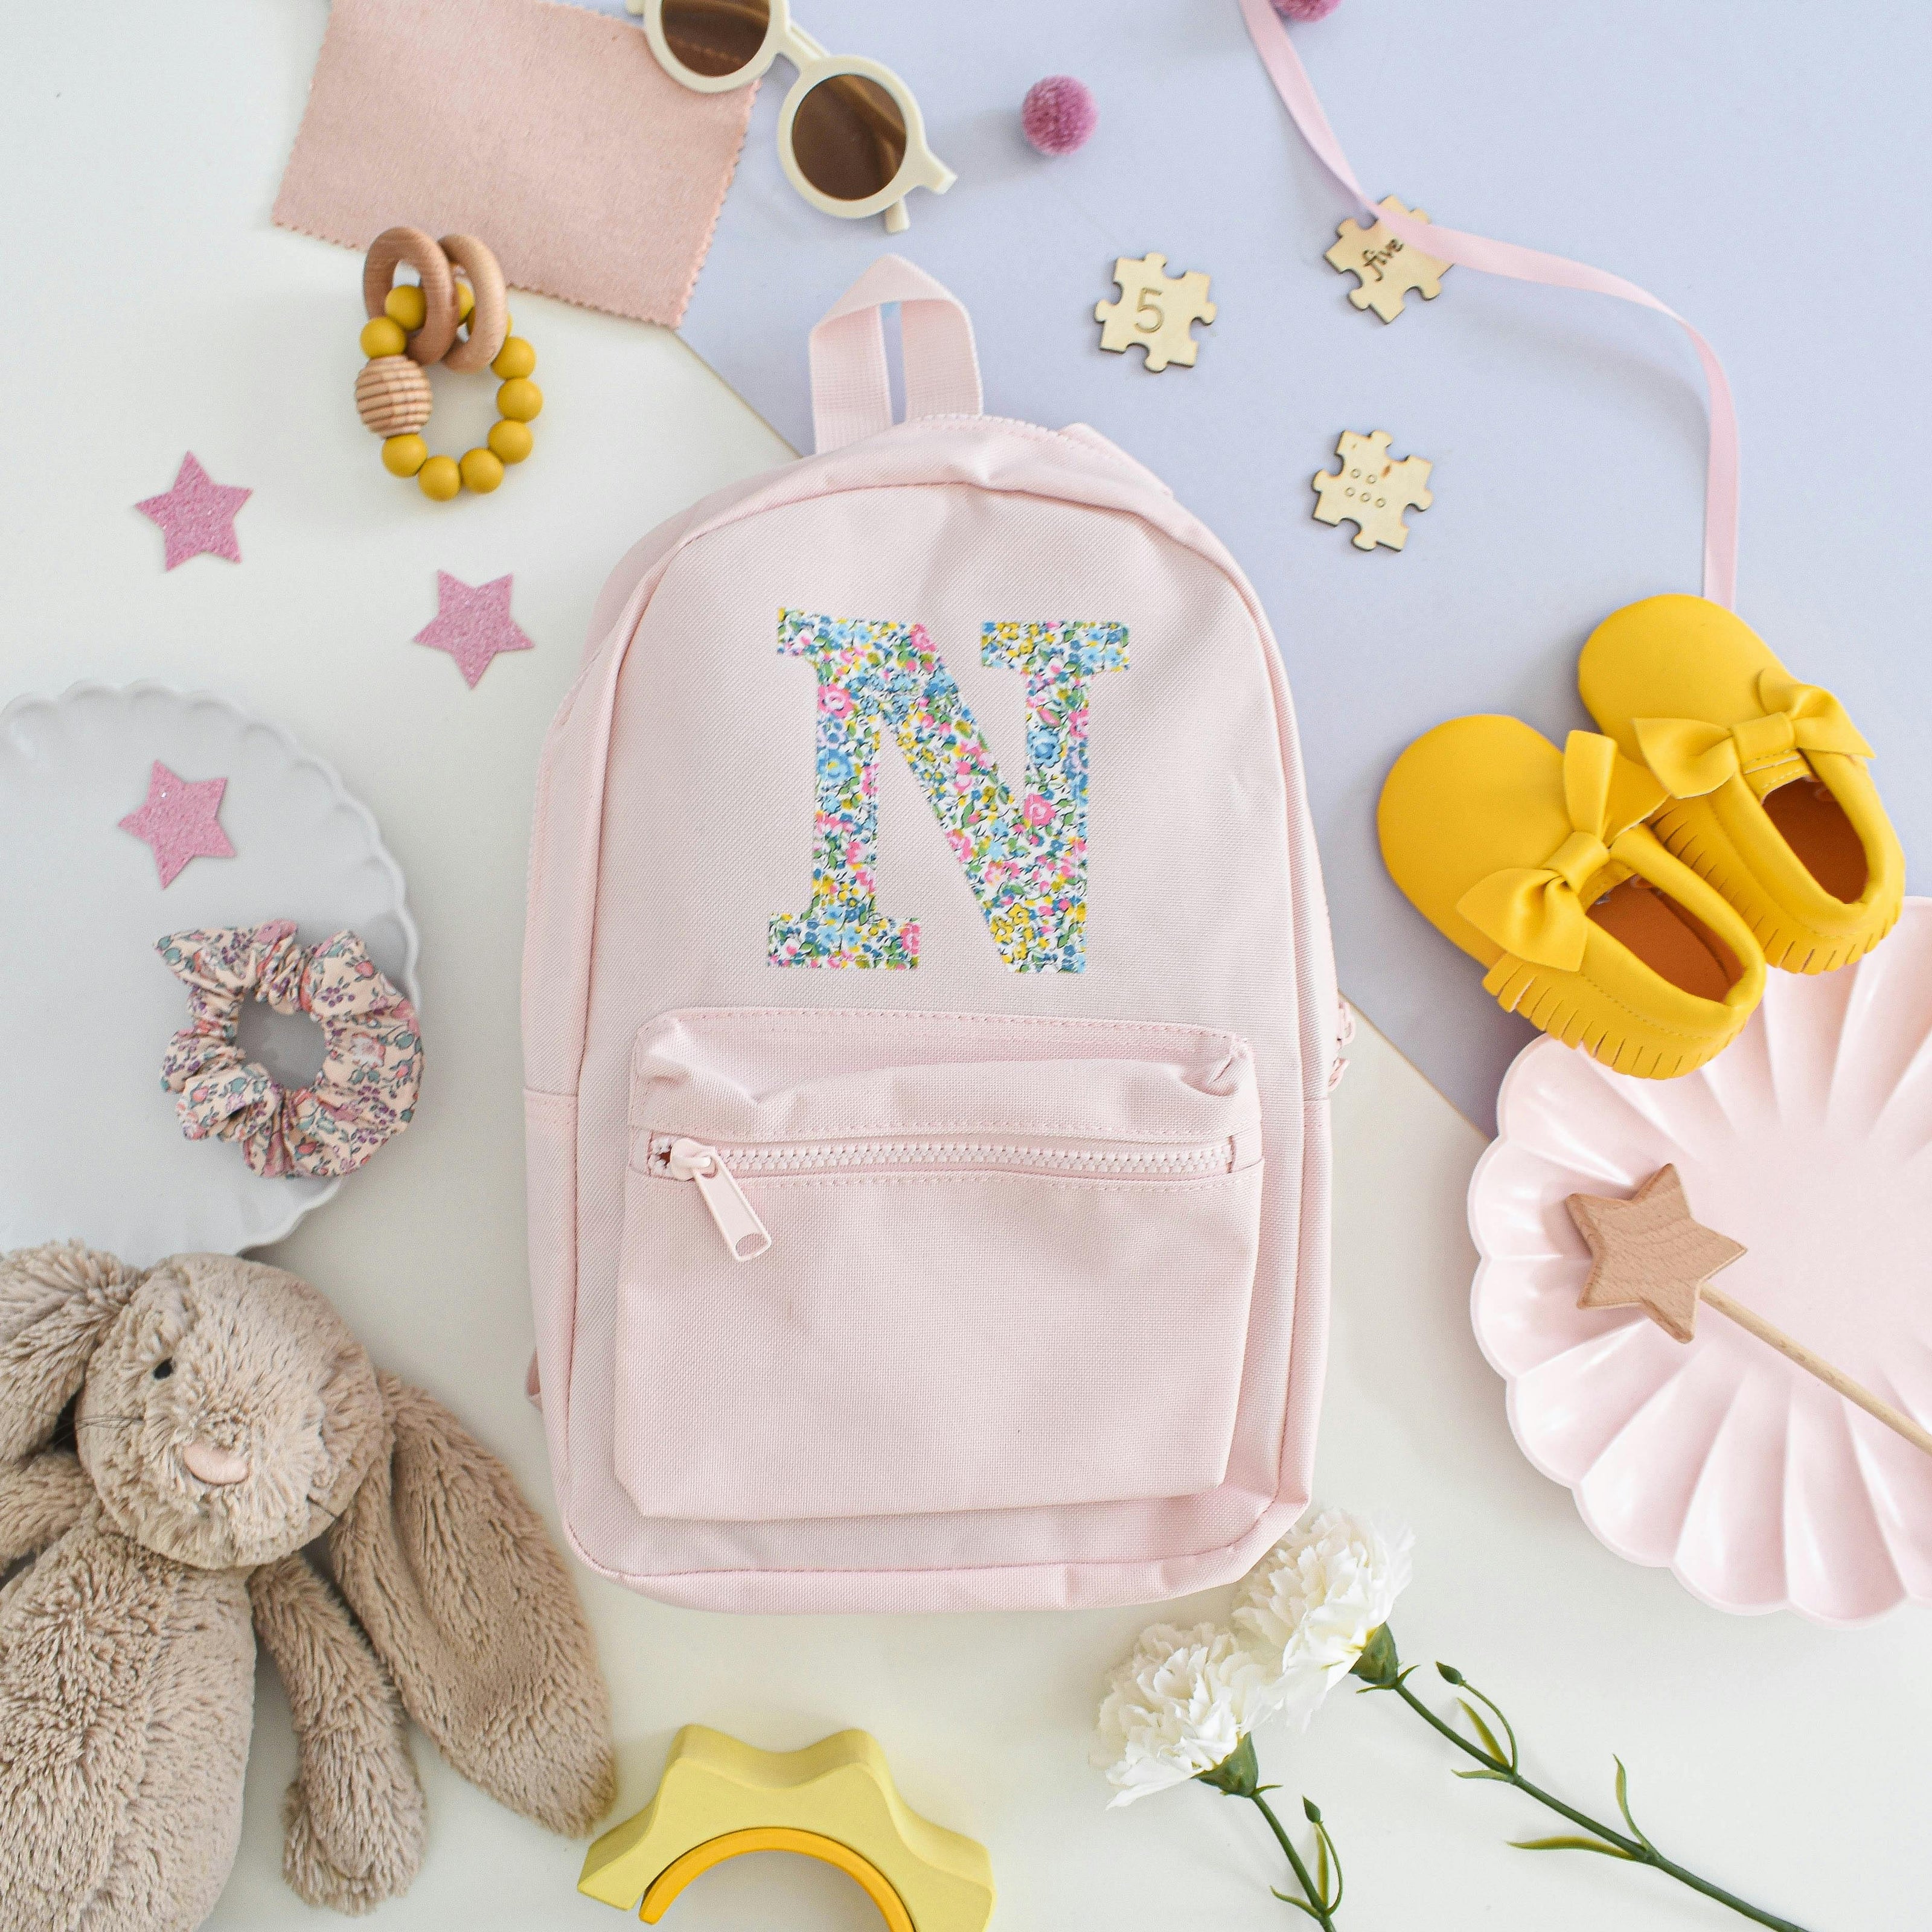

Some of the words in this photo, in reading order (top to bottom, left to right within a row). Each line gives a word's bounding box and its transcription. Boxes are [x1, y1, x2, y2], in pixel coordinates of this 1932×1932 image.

[1362, 238, 1404, 281] five
[1133, 286, 1165, 333] 5
[767, 607, 1130, 974] N
